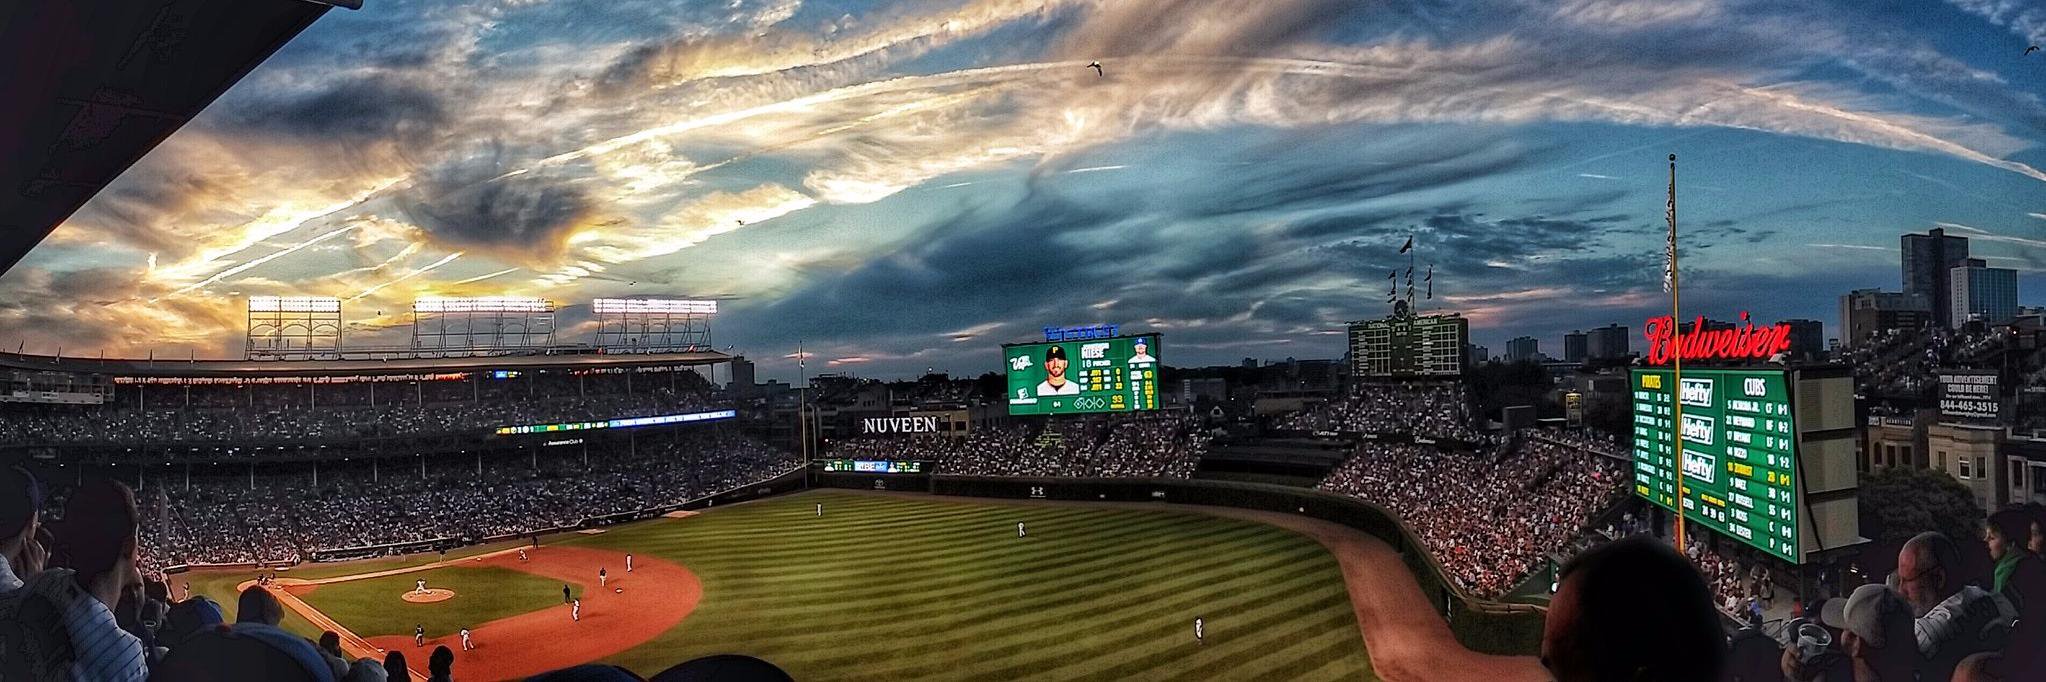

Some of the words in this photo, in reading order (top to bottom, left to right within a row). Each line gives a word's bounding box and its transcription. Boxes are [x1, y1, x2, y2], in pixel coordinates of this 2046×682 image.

[1645, 311, 1791, 365] Budweiser
[1744, 378, 1766, 396] CUBS
[1939, 375, 1953, 383] YOUR
[1954, 375, 1997, 384] ADVERTISEMENT
[1682, 382, 1709, 405] Hefty
[1948, 384, 1964, 393] COULD
[1966, 384, 1972, 393] BE
[1766, 403, 1772, 413] CF
[1778, 404, 1787, 415] 0-1
[864, 416, 937, 433] NUVEEN
[1684, 417, 1711, 442] Hefty
[1778, 421, 1788, 433] 0-2
[1684, 453, 1712, 480] Hefty
[1780, 456, 1789, 468] 1-2
[1781, 490, 1790, 503] 1-1
[1736, 509, 1748, 522] ROSS
[1769, 521, 1774, 532] C
[1770, 537, 1774, 548] P
